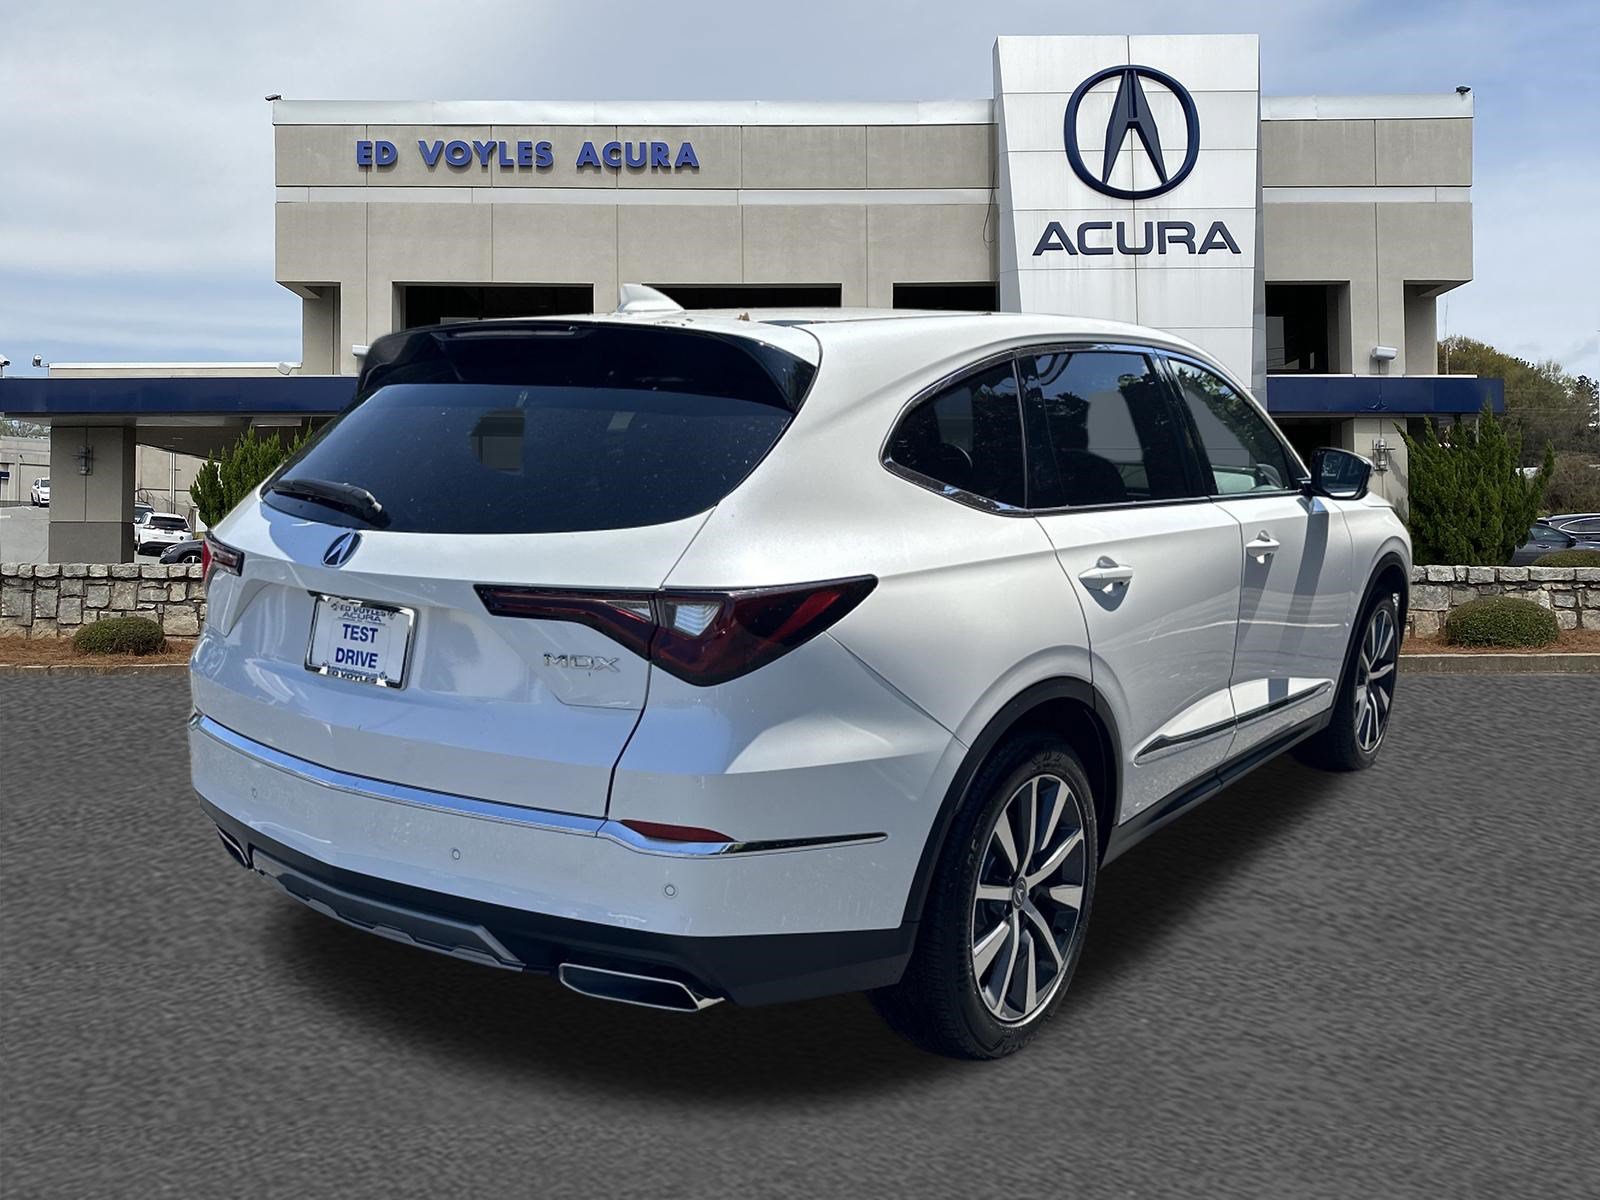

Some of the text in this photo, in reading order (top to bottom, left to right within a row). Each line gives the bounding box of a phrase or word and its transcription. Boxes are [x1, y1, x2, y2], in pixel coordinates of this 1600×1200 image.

[356, 140, 700, 170] ED VOYLES ACURA
[1032, 221, 1242, 256] ACURA
[342, 611, 382, 623] ACURA
[342, 623, 379, 644] TEST
[335, 647, 378, 669] DRIVE
[544, 653, 620, 673] MDX
